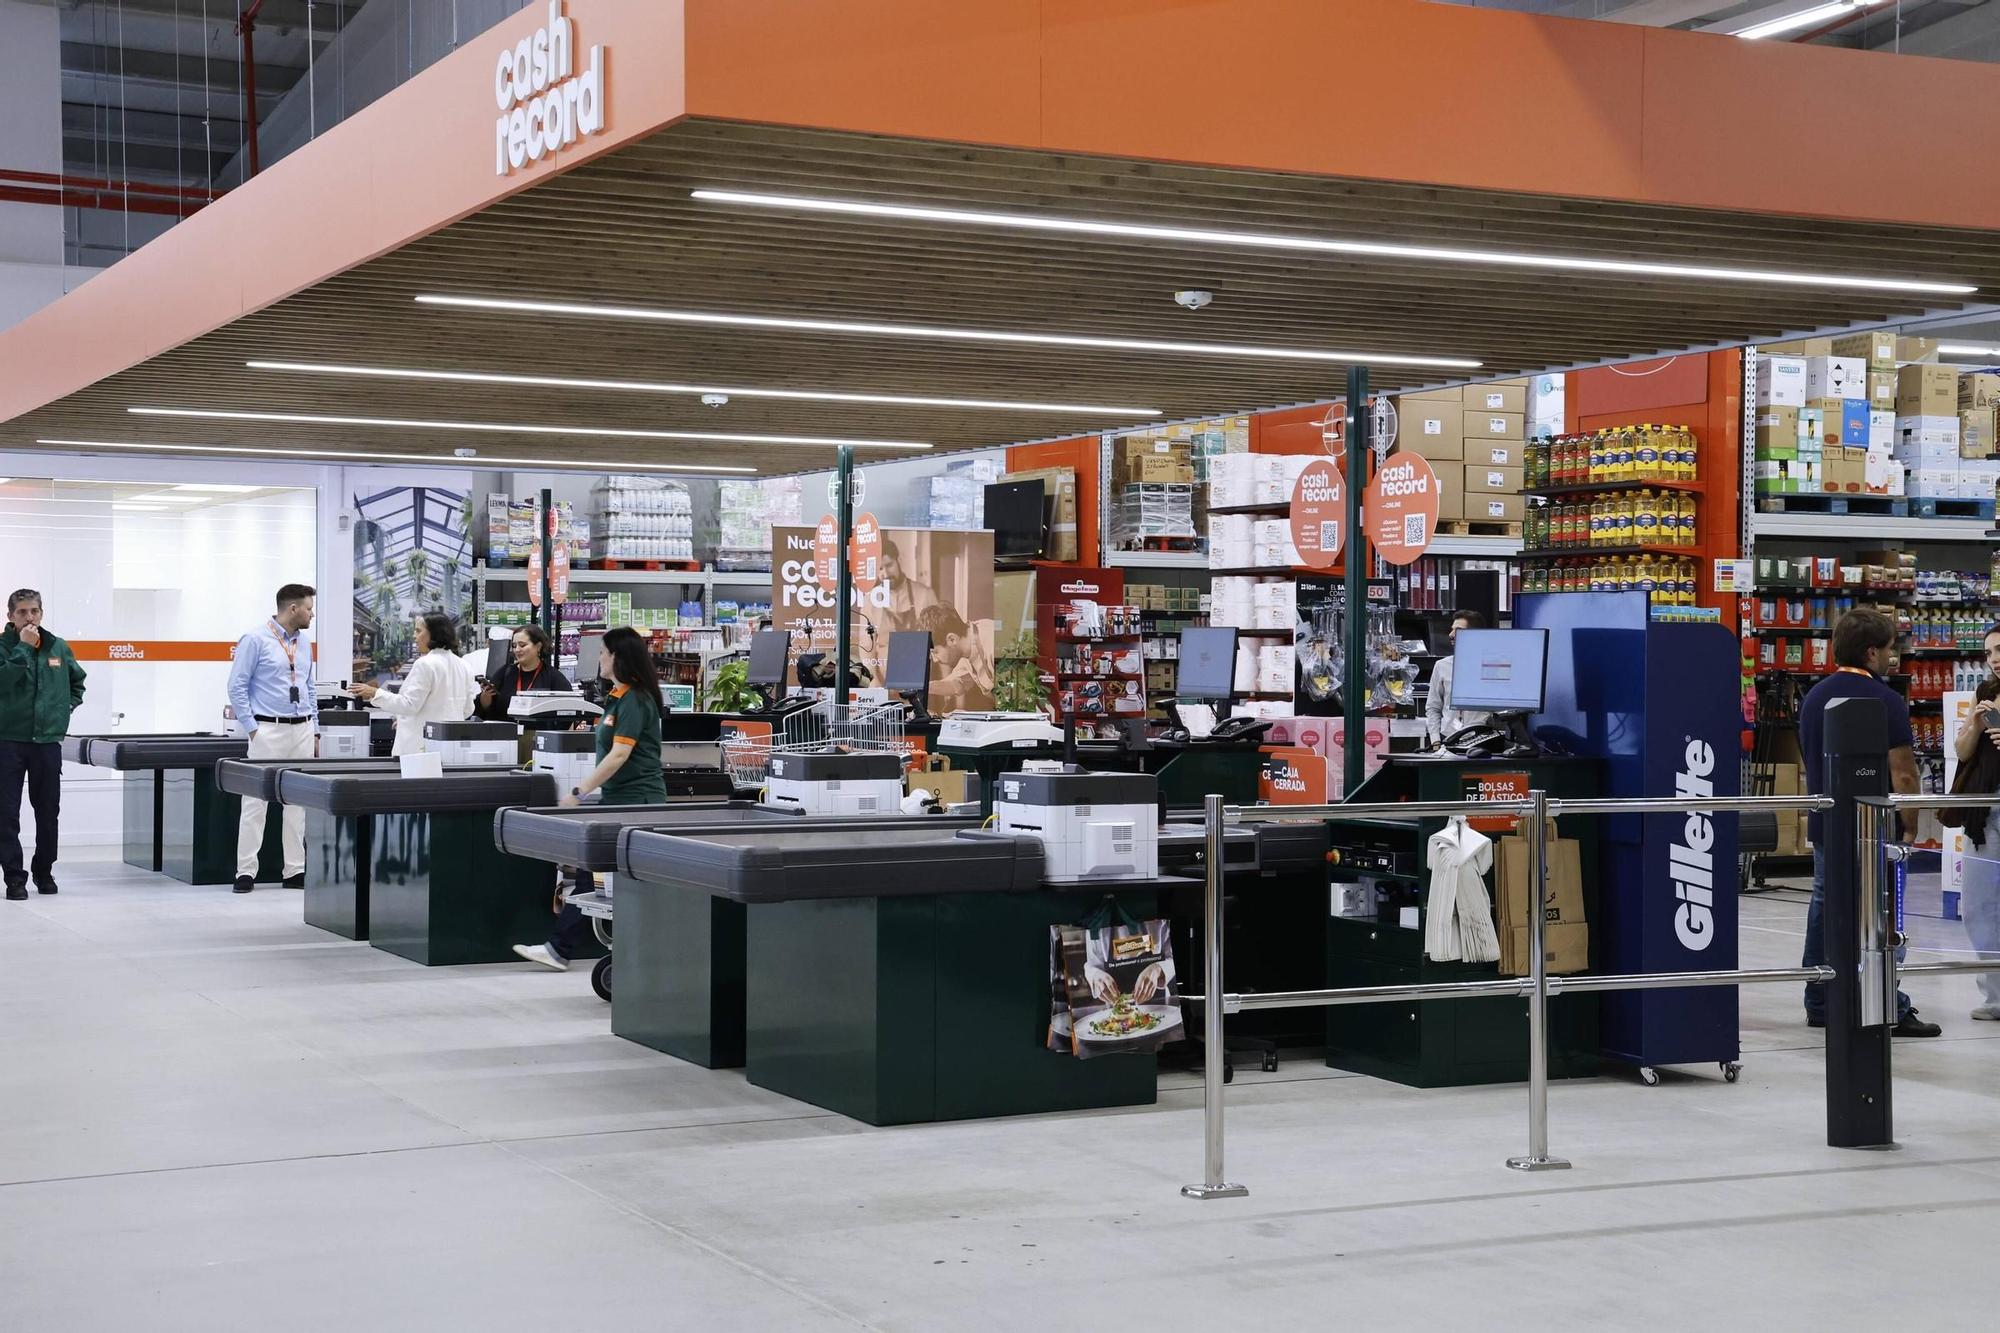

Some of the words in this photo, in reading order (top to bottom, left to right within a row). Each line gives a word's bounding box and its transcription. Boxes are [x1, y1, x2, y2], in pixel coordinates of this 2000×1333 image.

[496, 0, 573, 110] cash
[496, 45, 605, 176] record
[1302, 469, 1328, 488] cash
[1381, 461, 1414, 481] cash
[1302, 484, 1339, 502] record
[1381, 475, 1427, 496] record
[819, 521, 833, 534] cash
[857, 520, 871, 534] cash
[857, 529, 877, 545] record
[782, 579, 891, 608] recrd
[109, 643, 134, 653] cash
[109, 650, 144, 659] record
[1855, 768, 1877, 777] eGate
[1274, 778, 1306, 792] CERRADA
[1478, 782, 1515, 792] BOLSAS
[1479, 791, 1524, 801] PLÁSTICO
